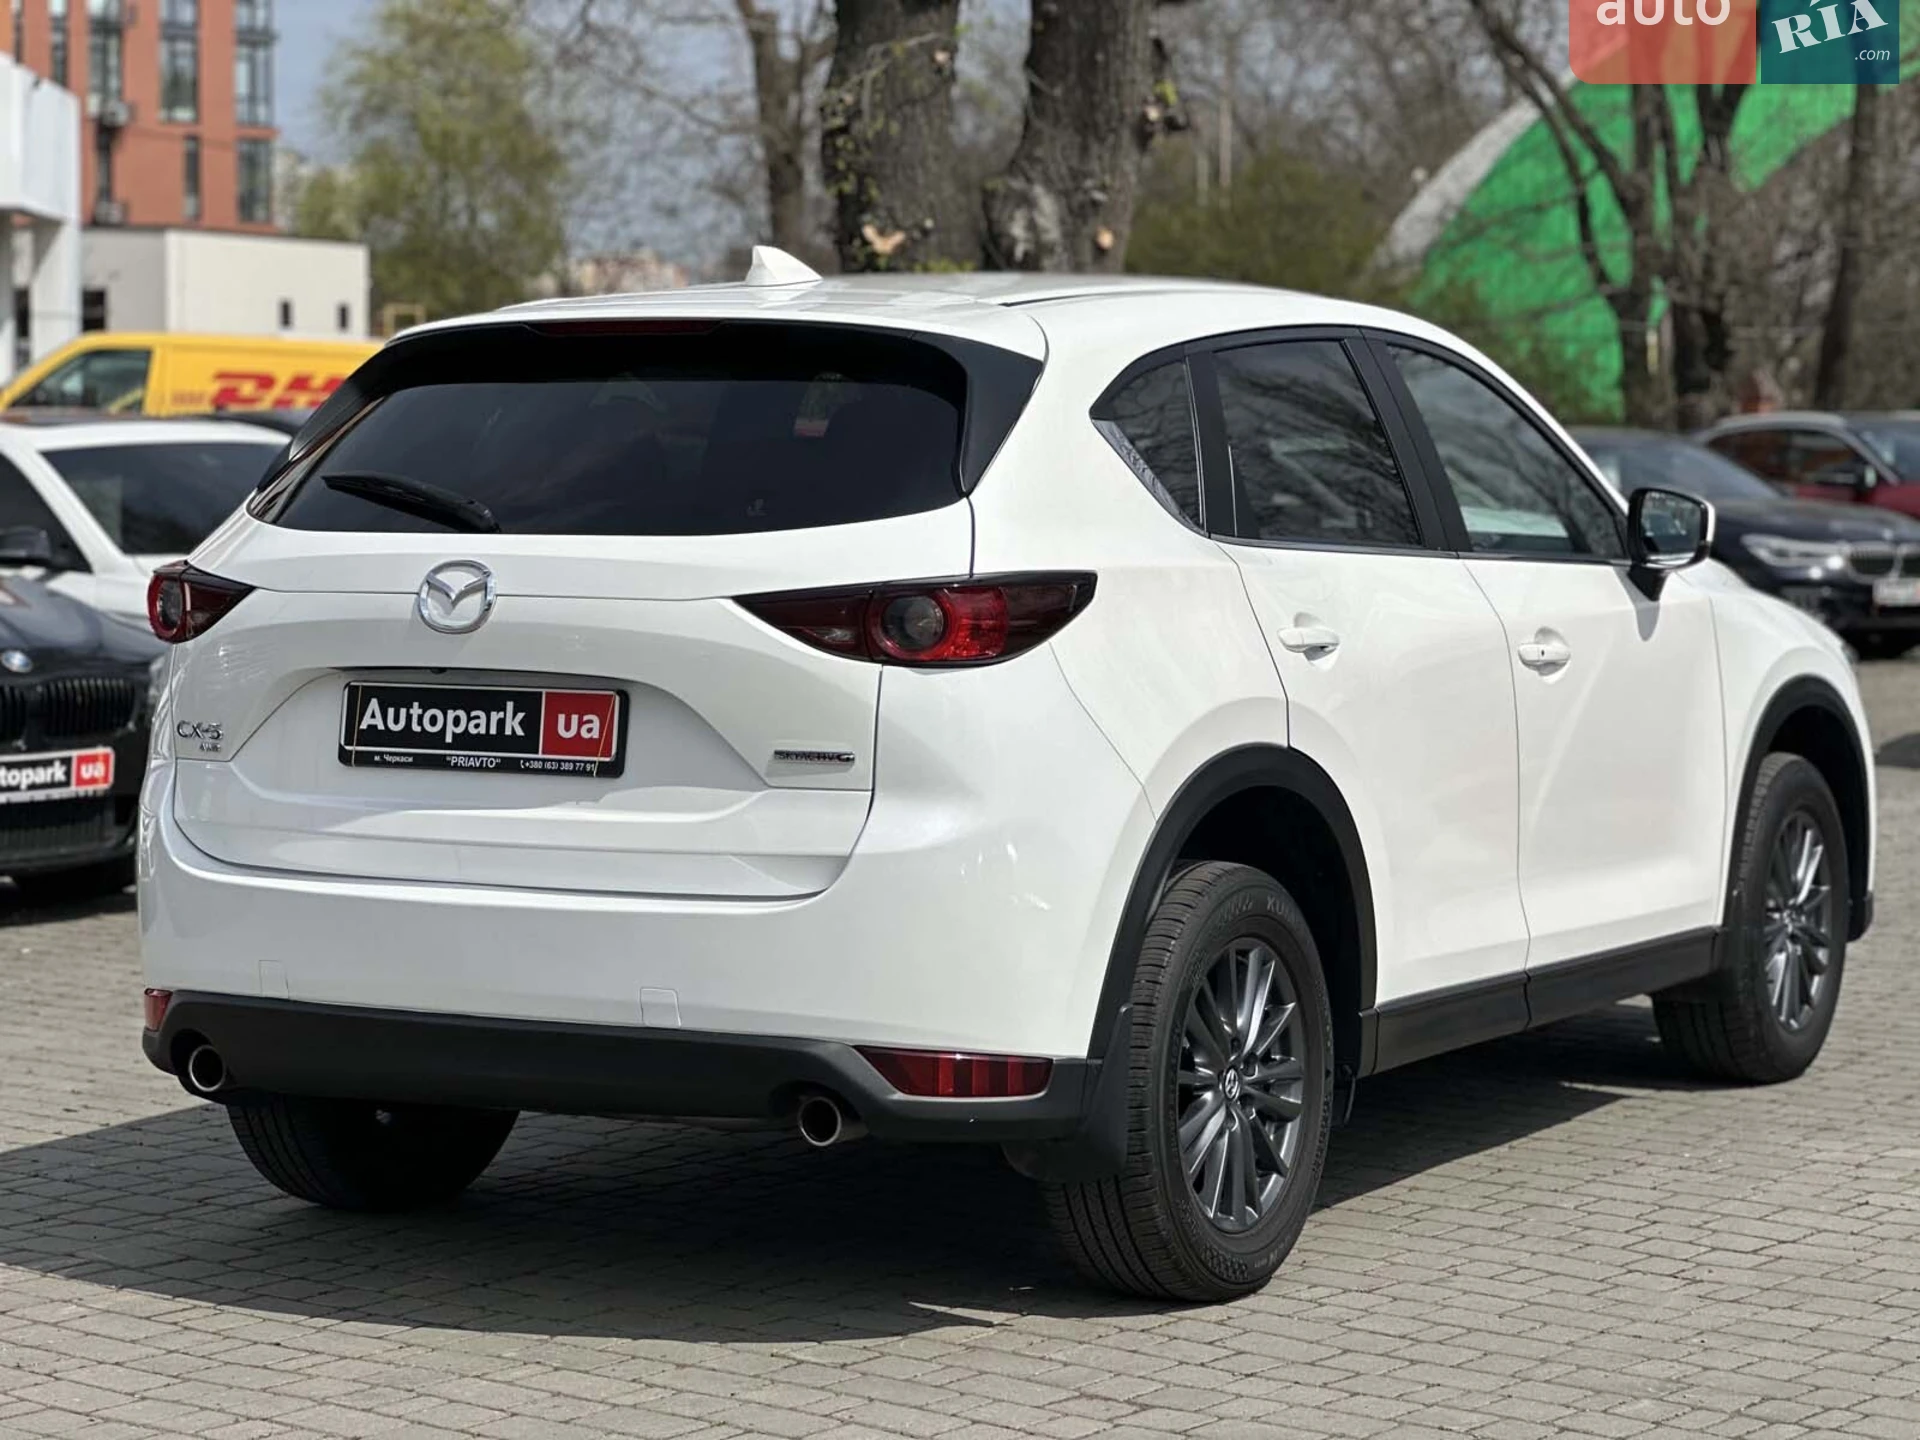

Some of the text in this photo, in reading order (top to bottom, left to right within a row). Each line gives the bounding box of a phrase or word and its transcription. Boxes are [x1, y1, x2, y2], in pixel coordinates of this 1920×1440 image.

[212, 371, 345, 408] DH
[177, 720, 222, 740] CX-5
[359, 697, 526, 744] Autopark
[557, 713, 600, 739] ua
[80, 762, 106, 780] ua
